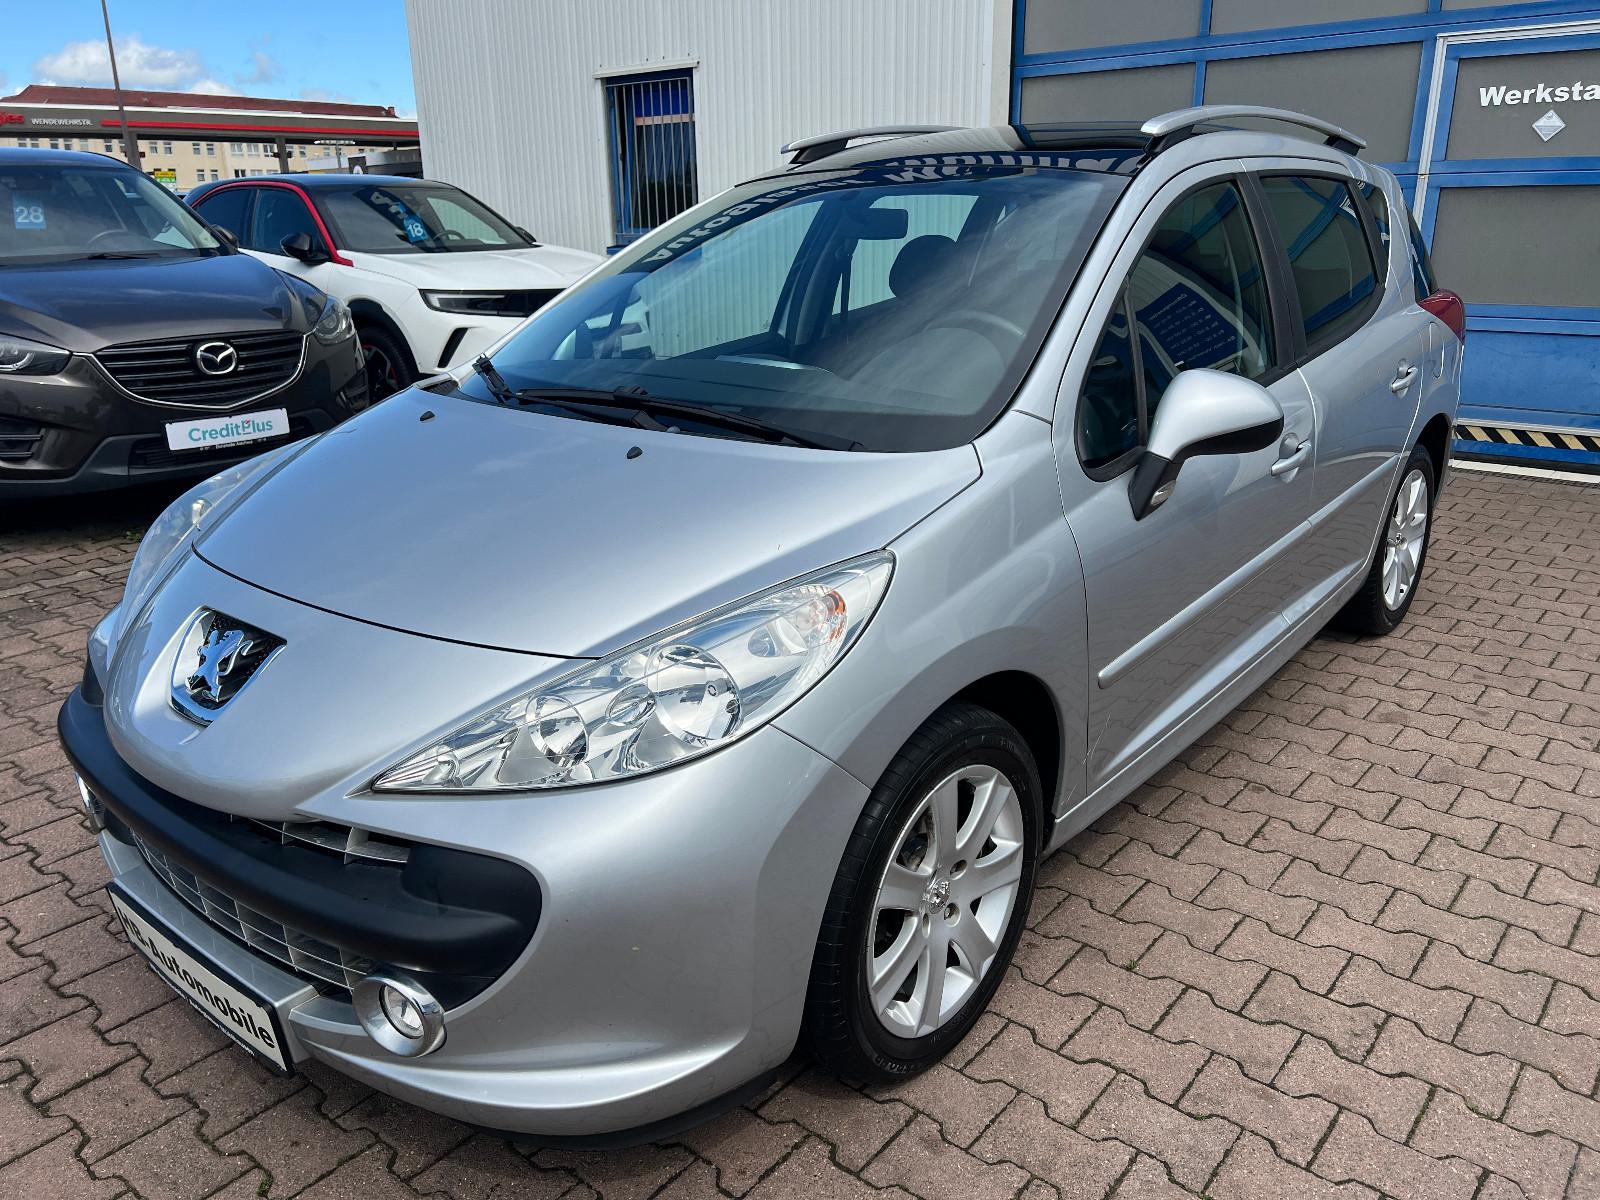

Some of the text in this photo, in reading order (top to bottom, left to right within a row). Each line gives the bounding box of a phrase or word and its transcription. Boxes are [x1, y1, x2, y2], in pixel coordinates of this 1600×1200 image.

[1479, 80, 1600, 107] Werksta
[15, 206, 44, 223] 28
[407, 222, 424, 238] 18
[188, 419, 273, 442] CreditPlus
